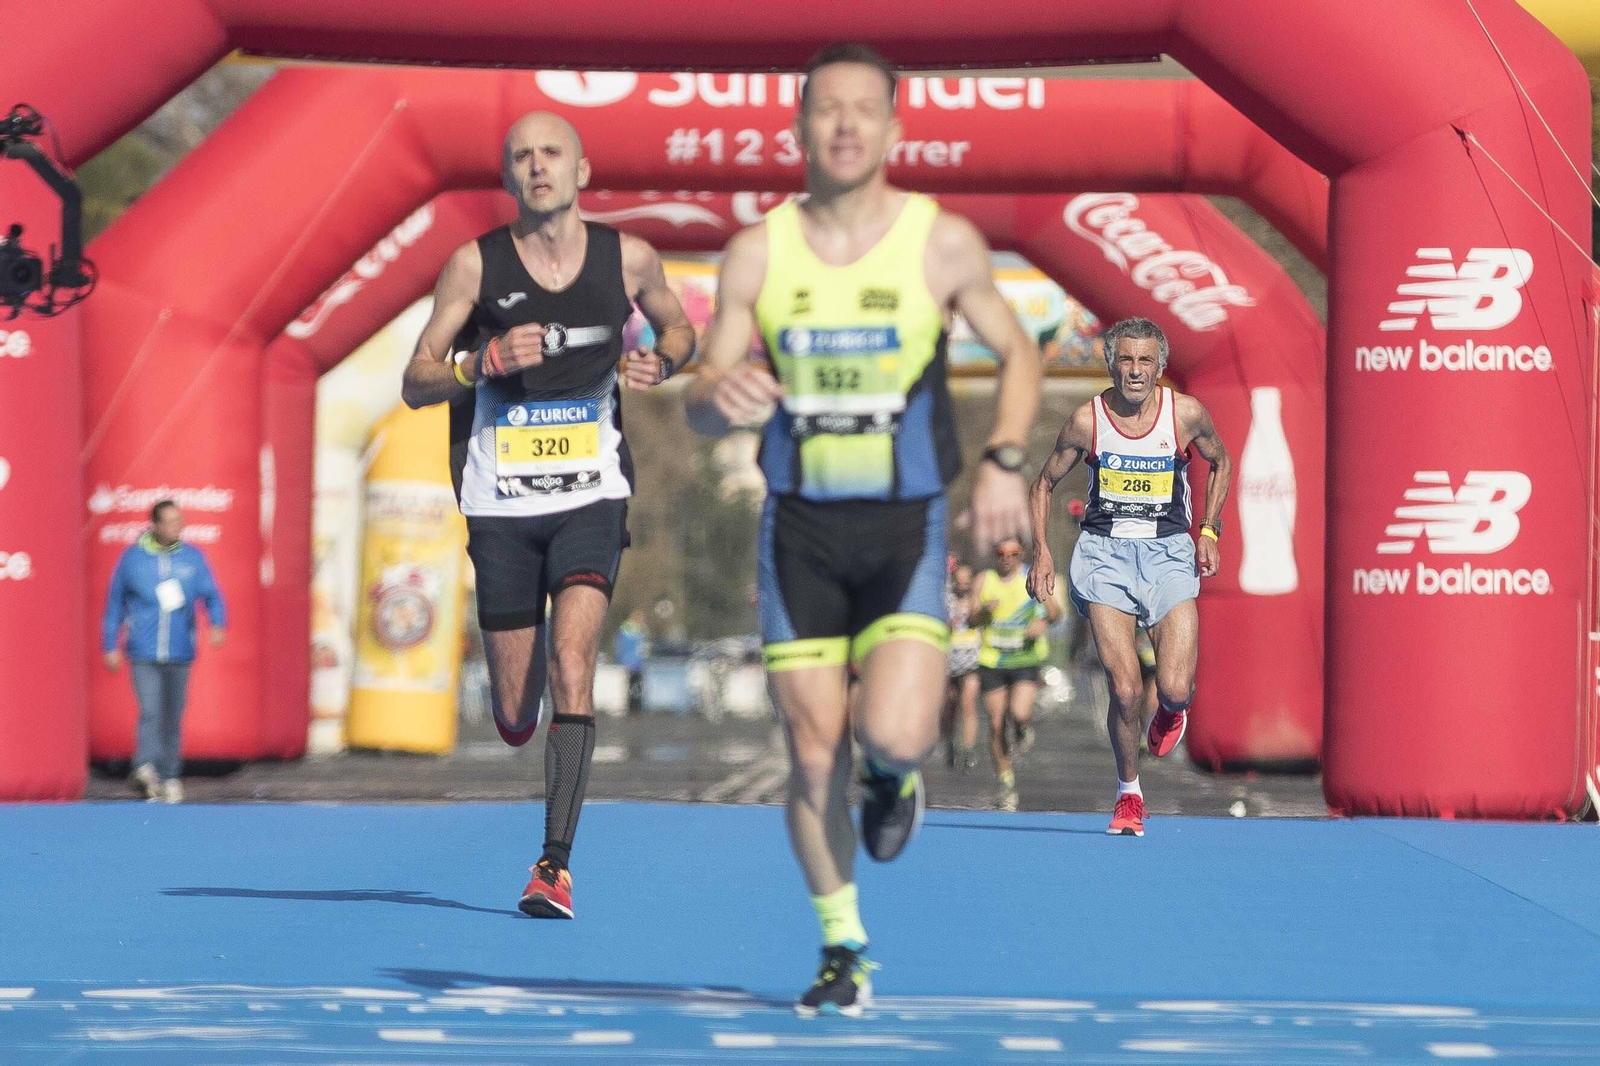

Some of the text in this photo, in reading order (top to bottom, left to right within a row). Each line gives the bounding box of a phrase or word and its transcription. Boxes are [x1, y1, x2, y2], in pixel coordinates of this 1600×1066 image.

[1355, 338, 1552, 372] new balance
[530, 406, 588, 424] ZURICH
[531, 437, 570, 457] 320
[1124, 459, 1166, 470] ZURICH
[1122, 479, 1151, 493] 286
[1353, 561, 1551, 595] new balance
